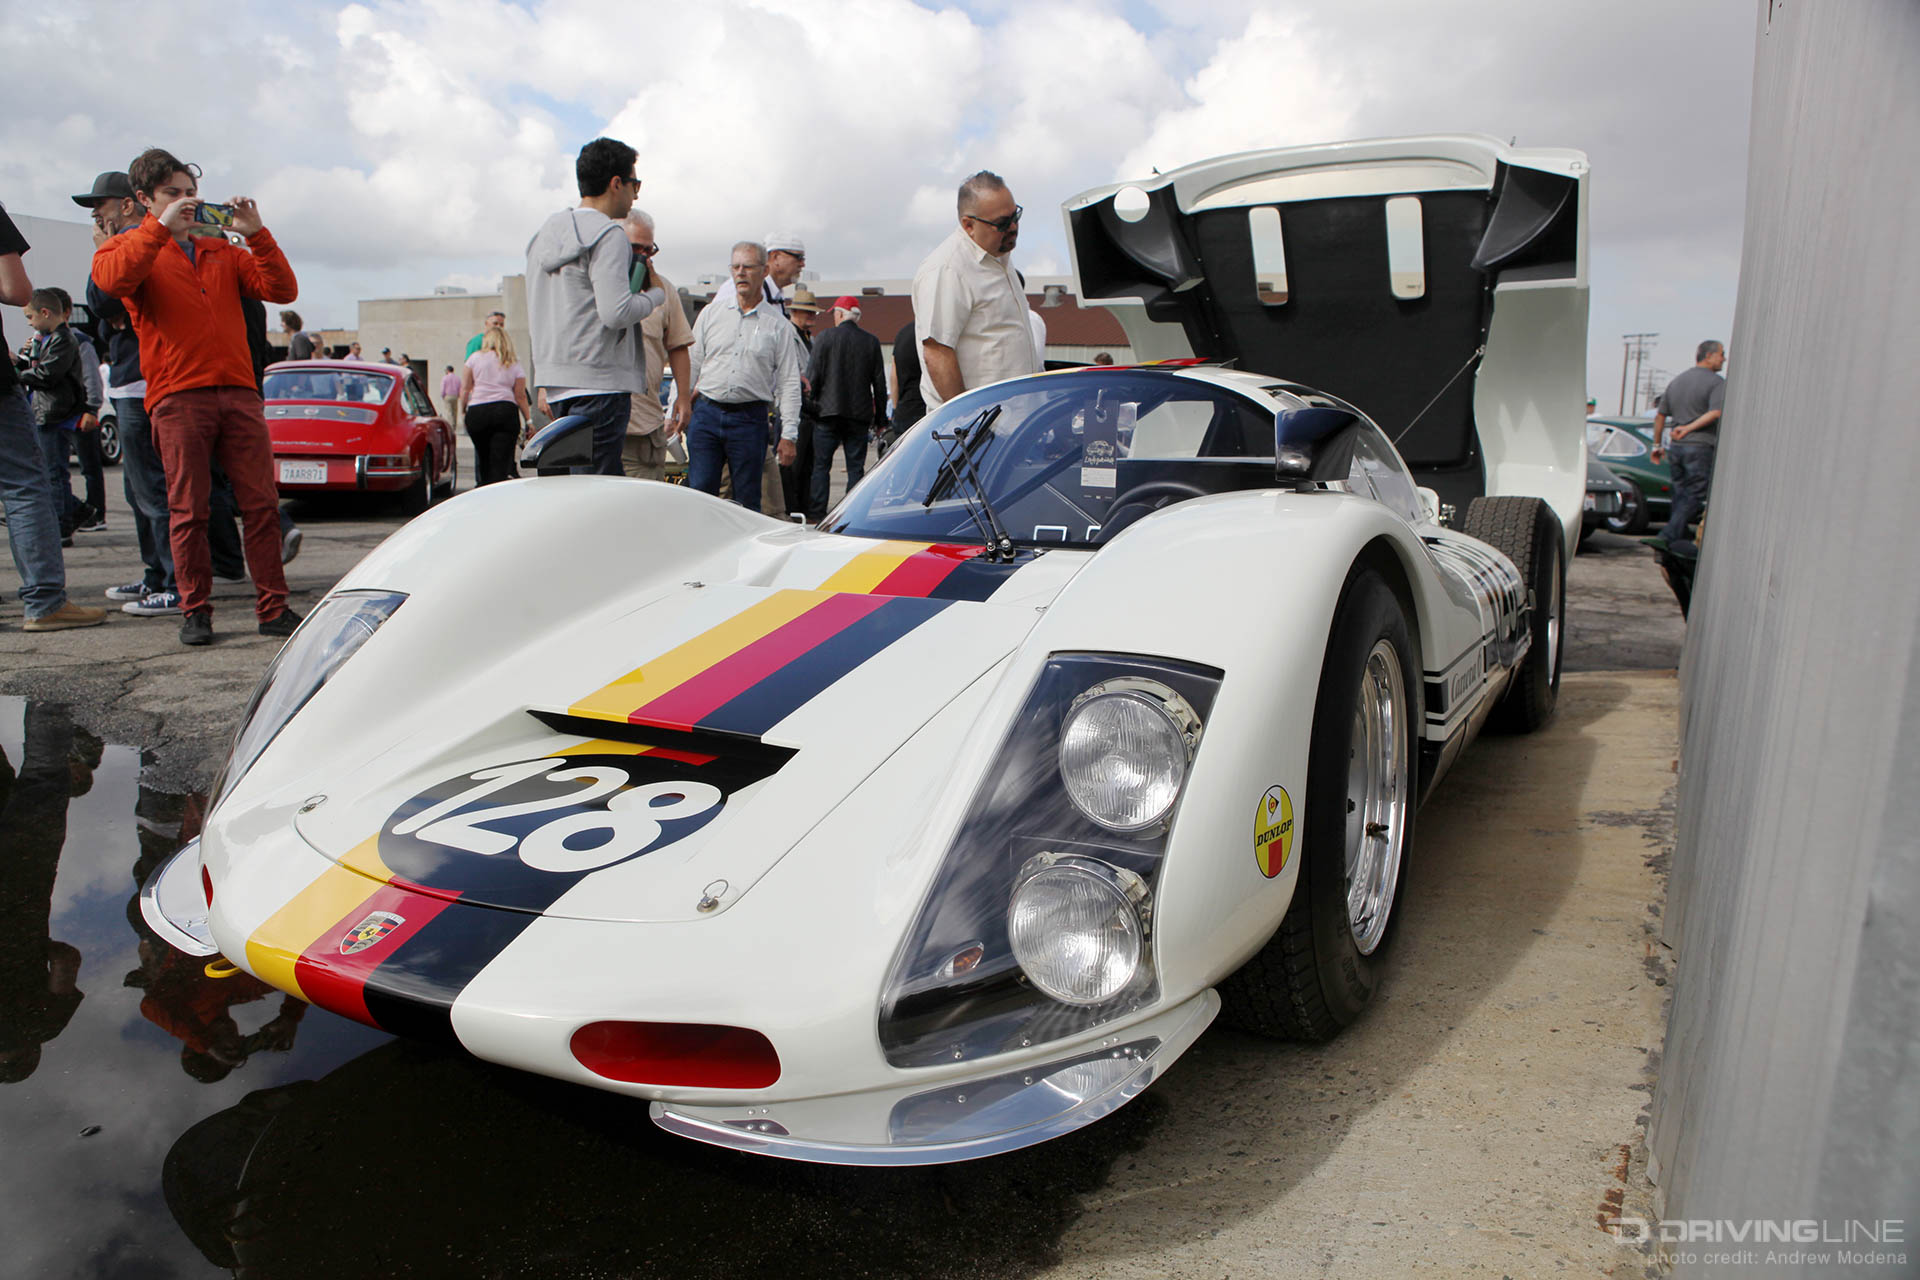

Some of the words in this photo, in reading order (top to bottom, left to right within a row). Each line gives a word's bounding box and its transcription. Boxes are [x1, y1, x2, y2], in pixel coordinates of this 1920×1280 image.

[284, 468, 323, 480] 7AAR871
[392, 758, 722, 872] 128
[1257, 819, 1292, 847] DUNLOP
